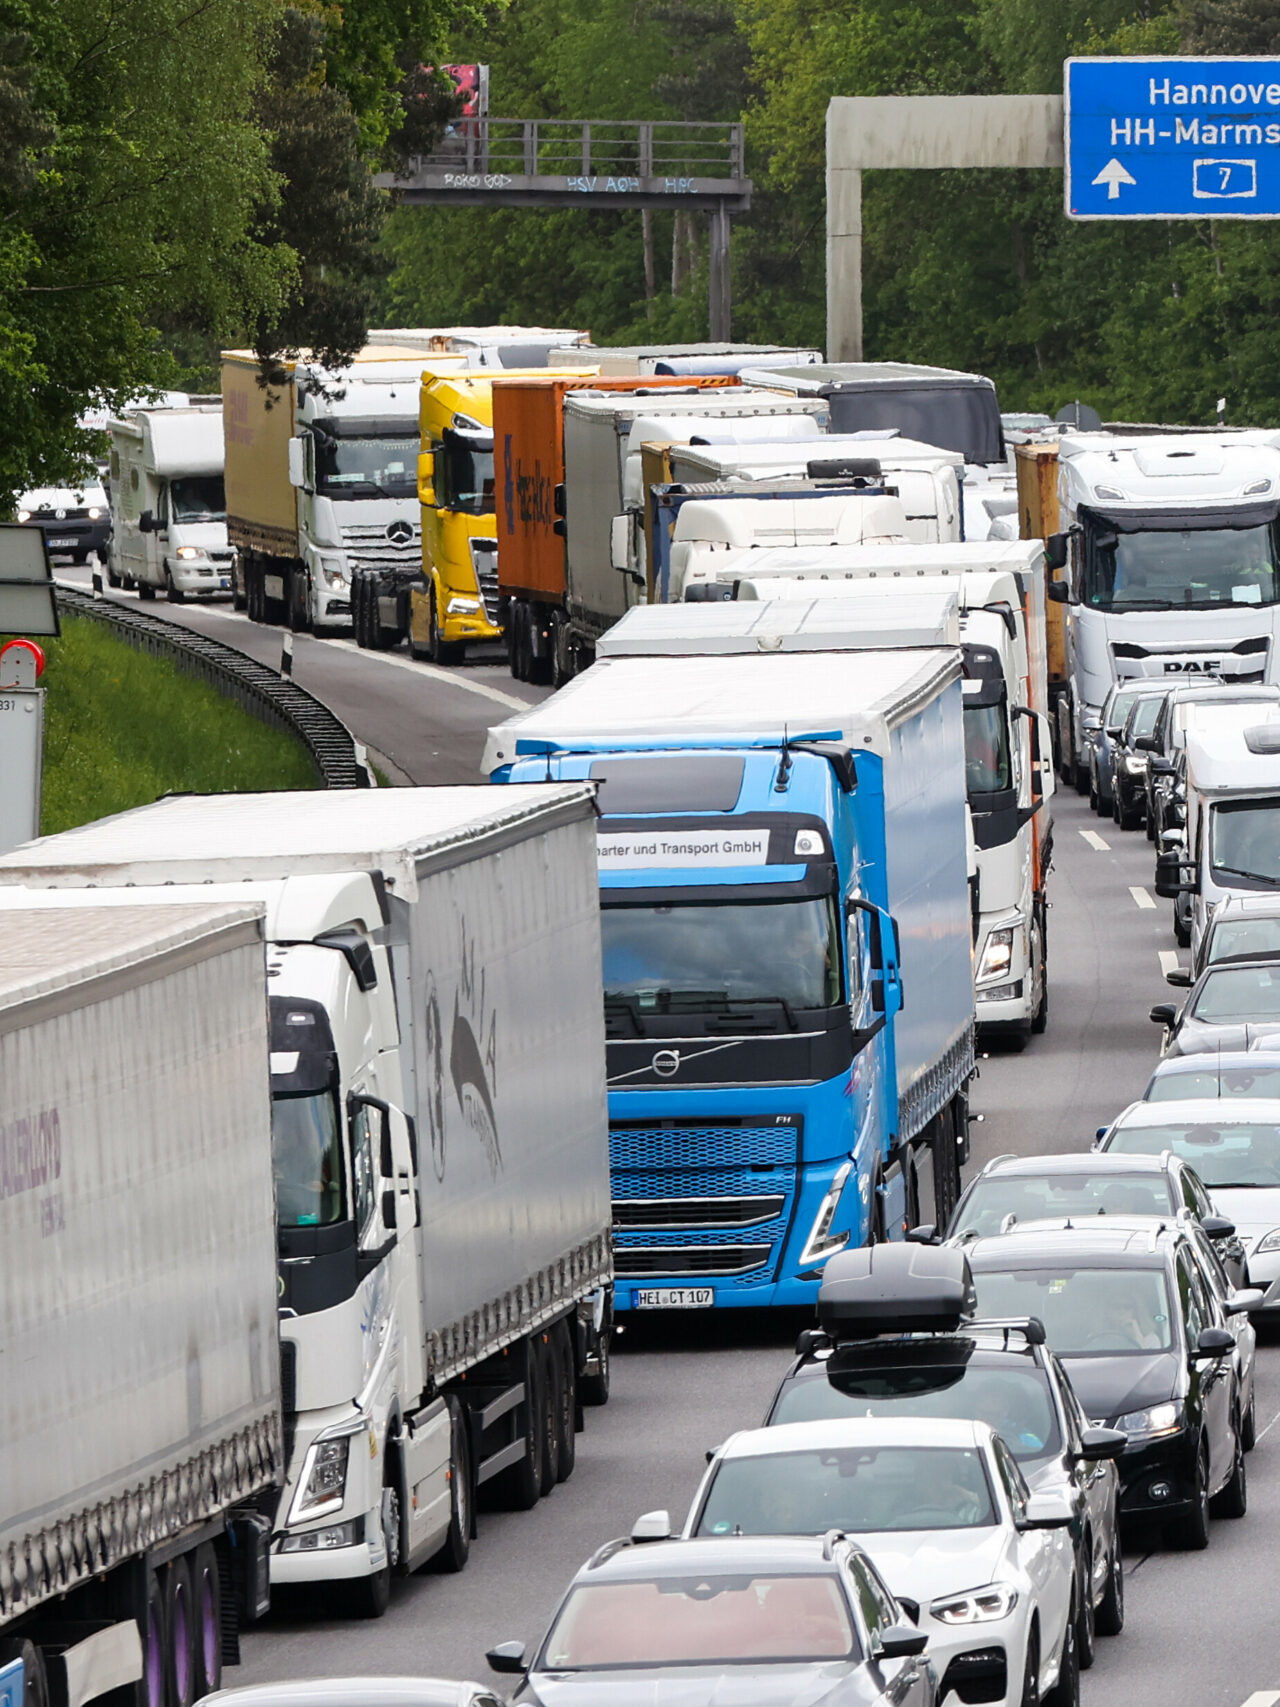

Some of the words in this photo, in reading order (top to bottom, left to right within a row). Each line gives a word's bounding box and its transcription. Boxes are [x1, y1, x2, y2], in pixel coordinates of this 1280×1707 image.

[1219, 167, 1231, 190] 7
[1164, 660, 1221, 672] DAF
[633, 843, 656, 855] und
[660, 842, 720, 857] Transport
[722, 841, 762, 854] GmbH
[775, 1115, 792, 1124] FH
[640, 1291, 661, 1305] HEI
[669, 1290, 685, 1304] CT
[688, 1290, 710, 1303] 107
